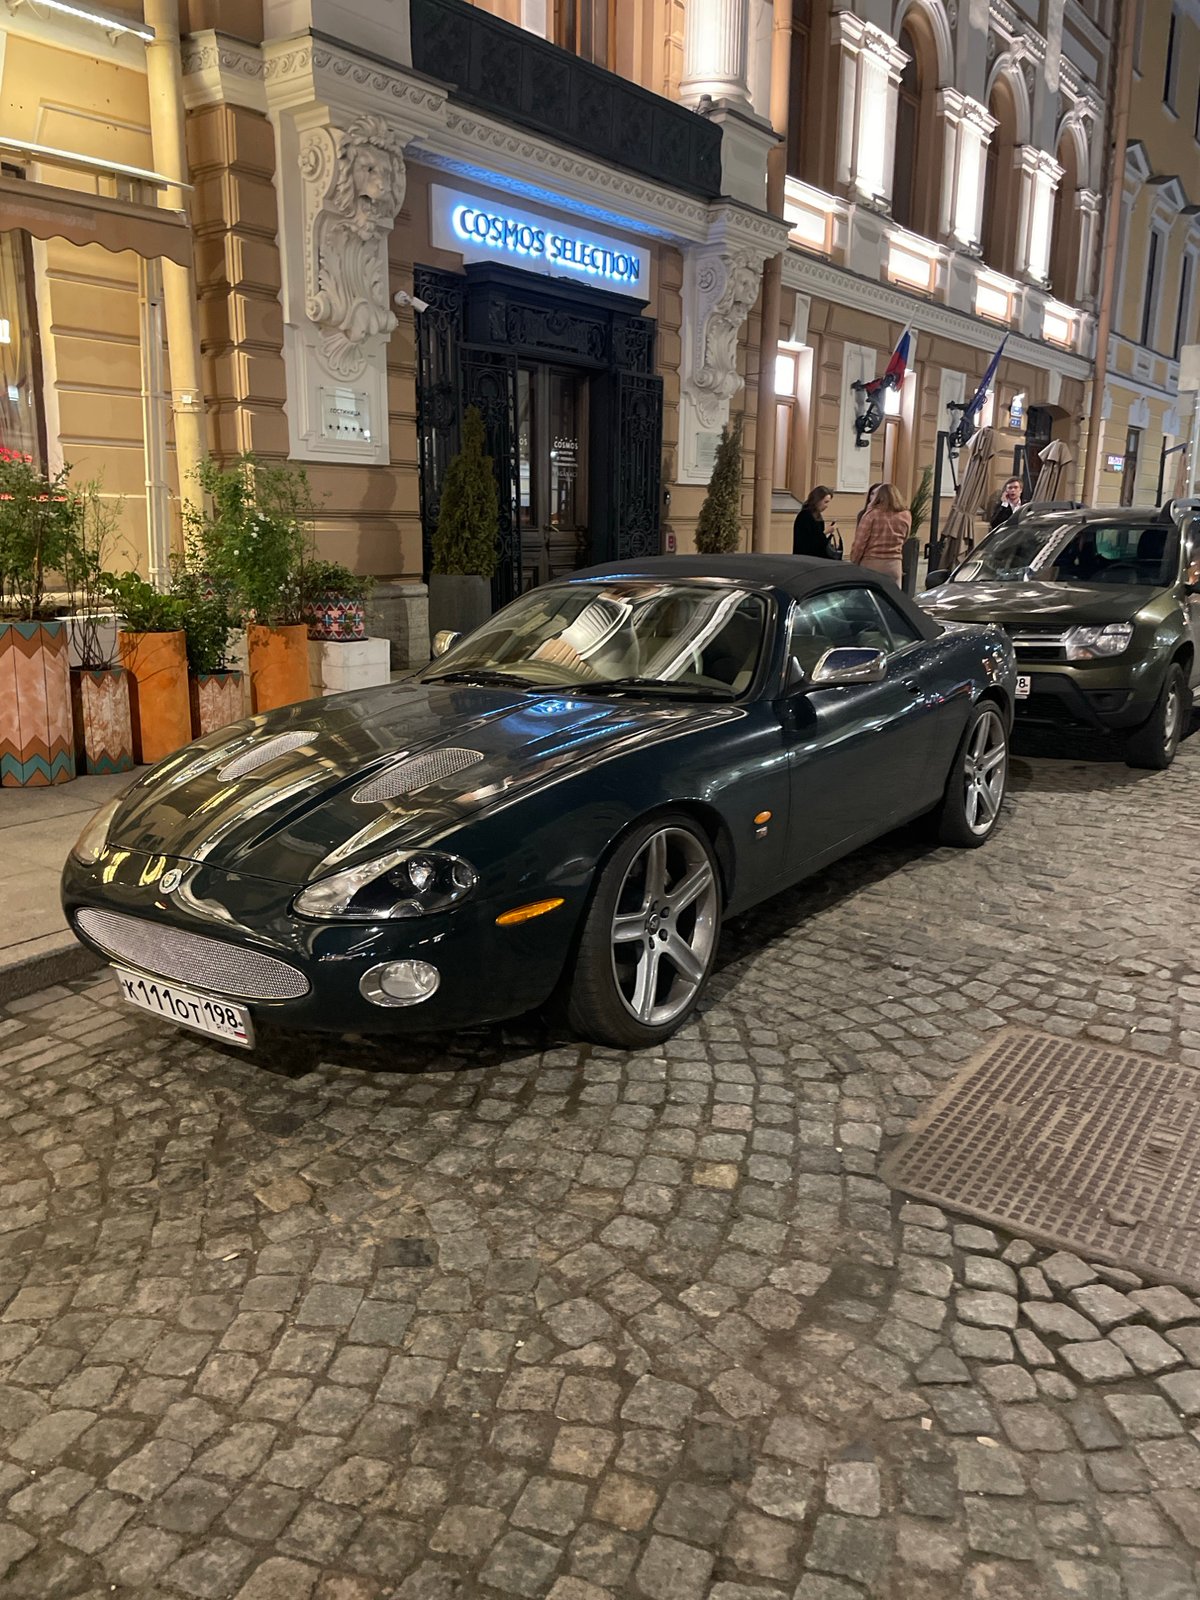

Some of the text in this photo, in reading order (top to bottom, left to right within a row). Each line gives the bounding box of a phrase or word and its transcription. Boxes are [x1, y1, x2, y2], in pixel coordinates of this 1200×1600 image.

[459, 208, 640, 280] COSMOS SELECTION
[553, 440, 579, 450] COSMOS
[204, 1001, 238, 1028] 198
